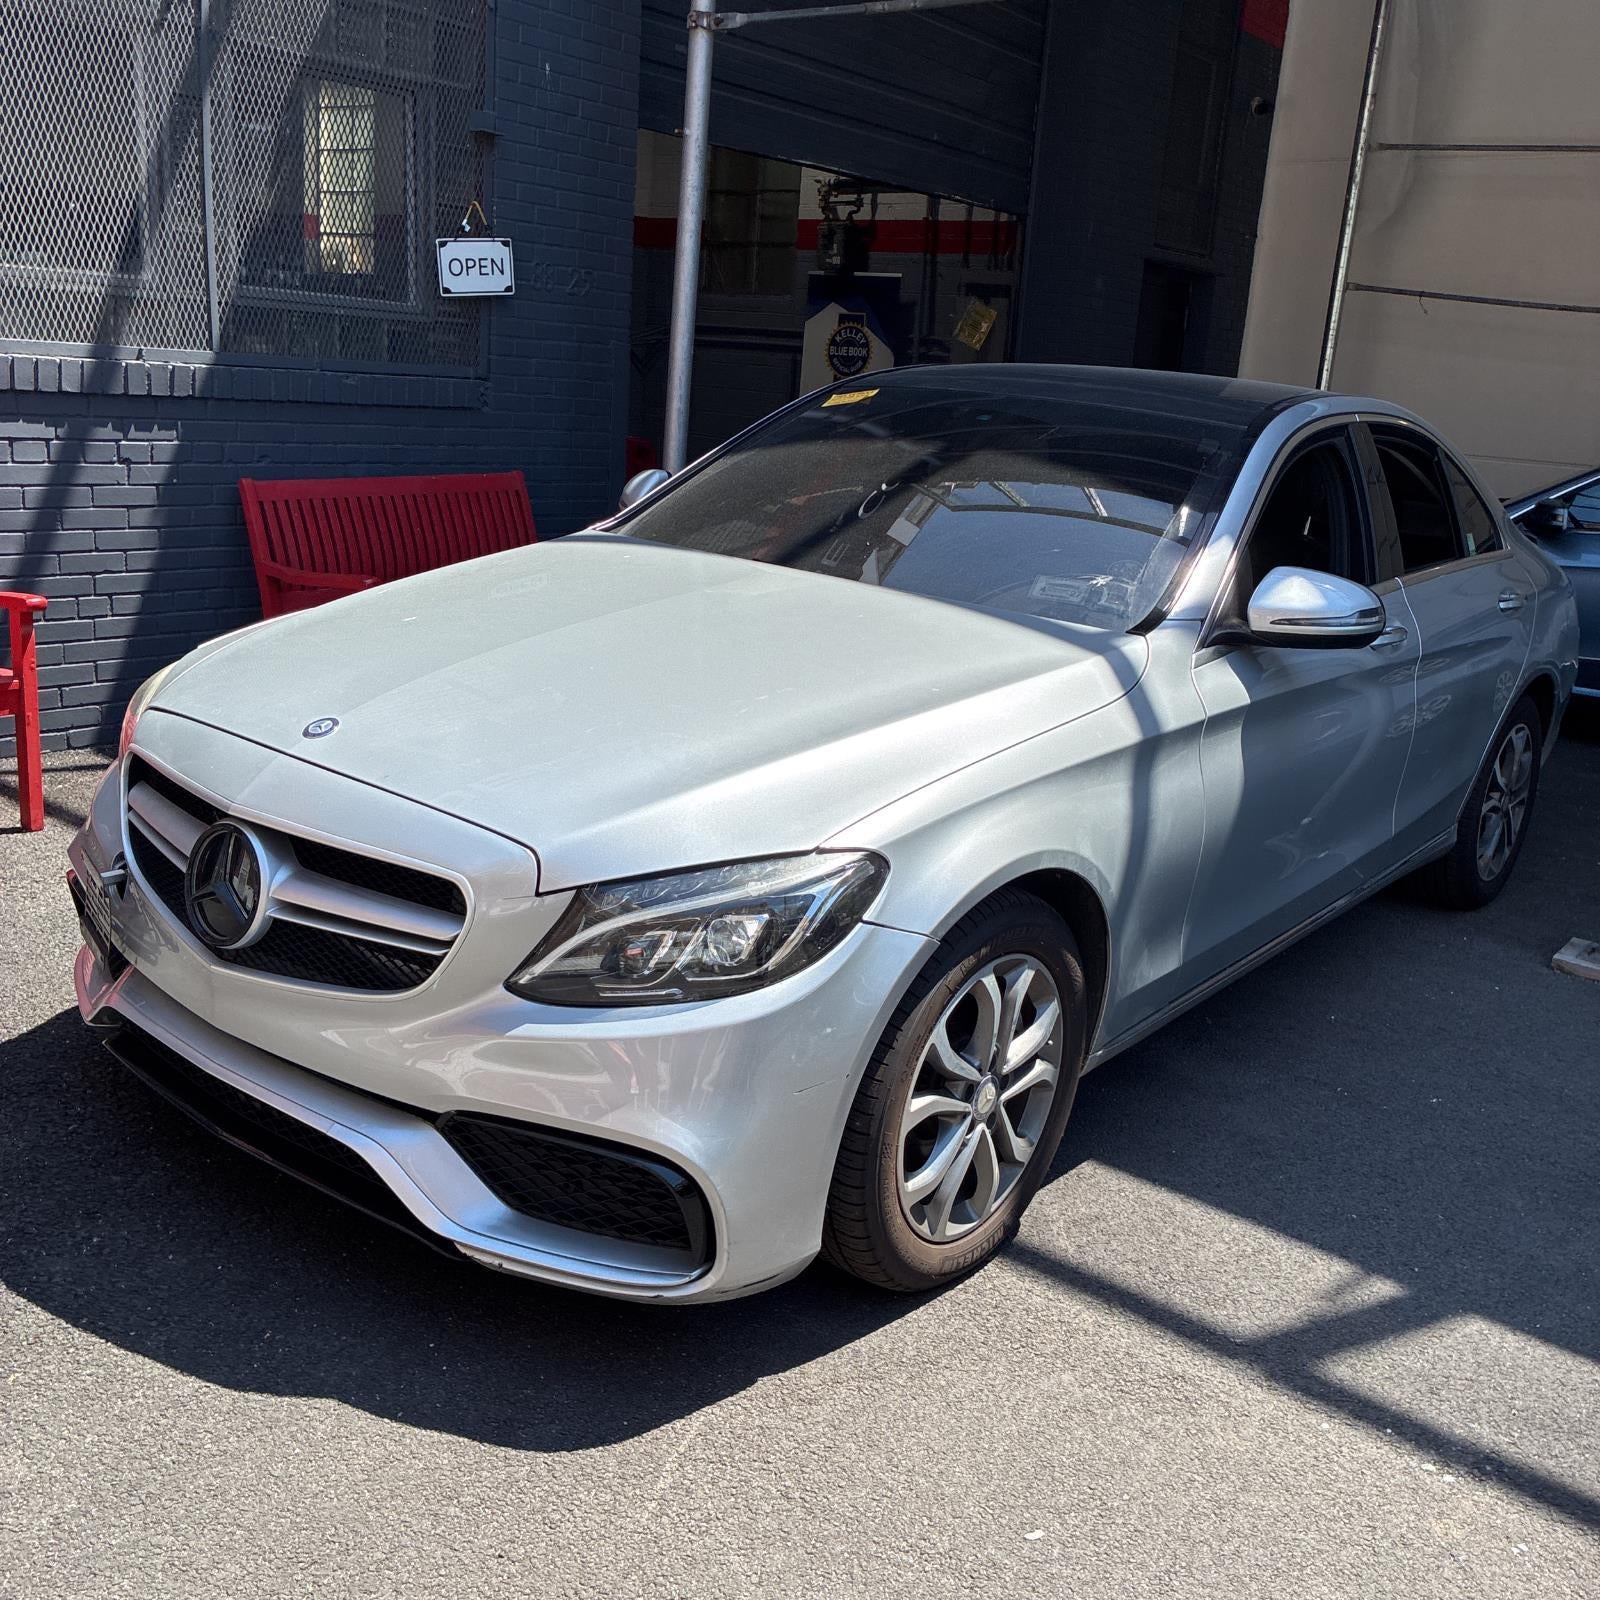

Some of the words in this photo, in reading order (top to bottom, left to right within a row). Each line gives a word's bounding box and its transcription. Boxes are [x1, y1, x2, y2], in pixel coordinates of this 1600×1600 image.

[448, 257, 505, 277] OPEN
[834, 327, 867, 344] KELLEY
[829, 345, 848, 356] BLUE
[848, 346, 868, 357] BOOK
